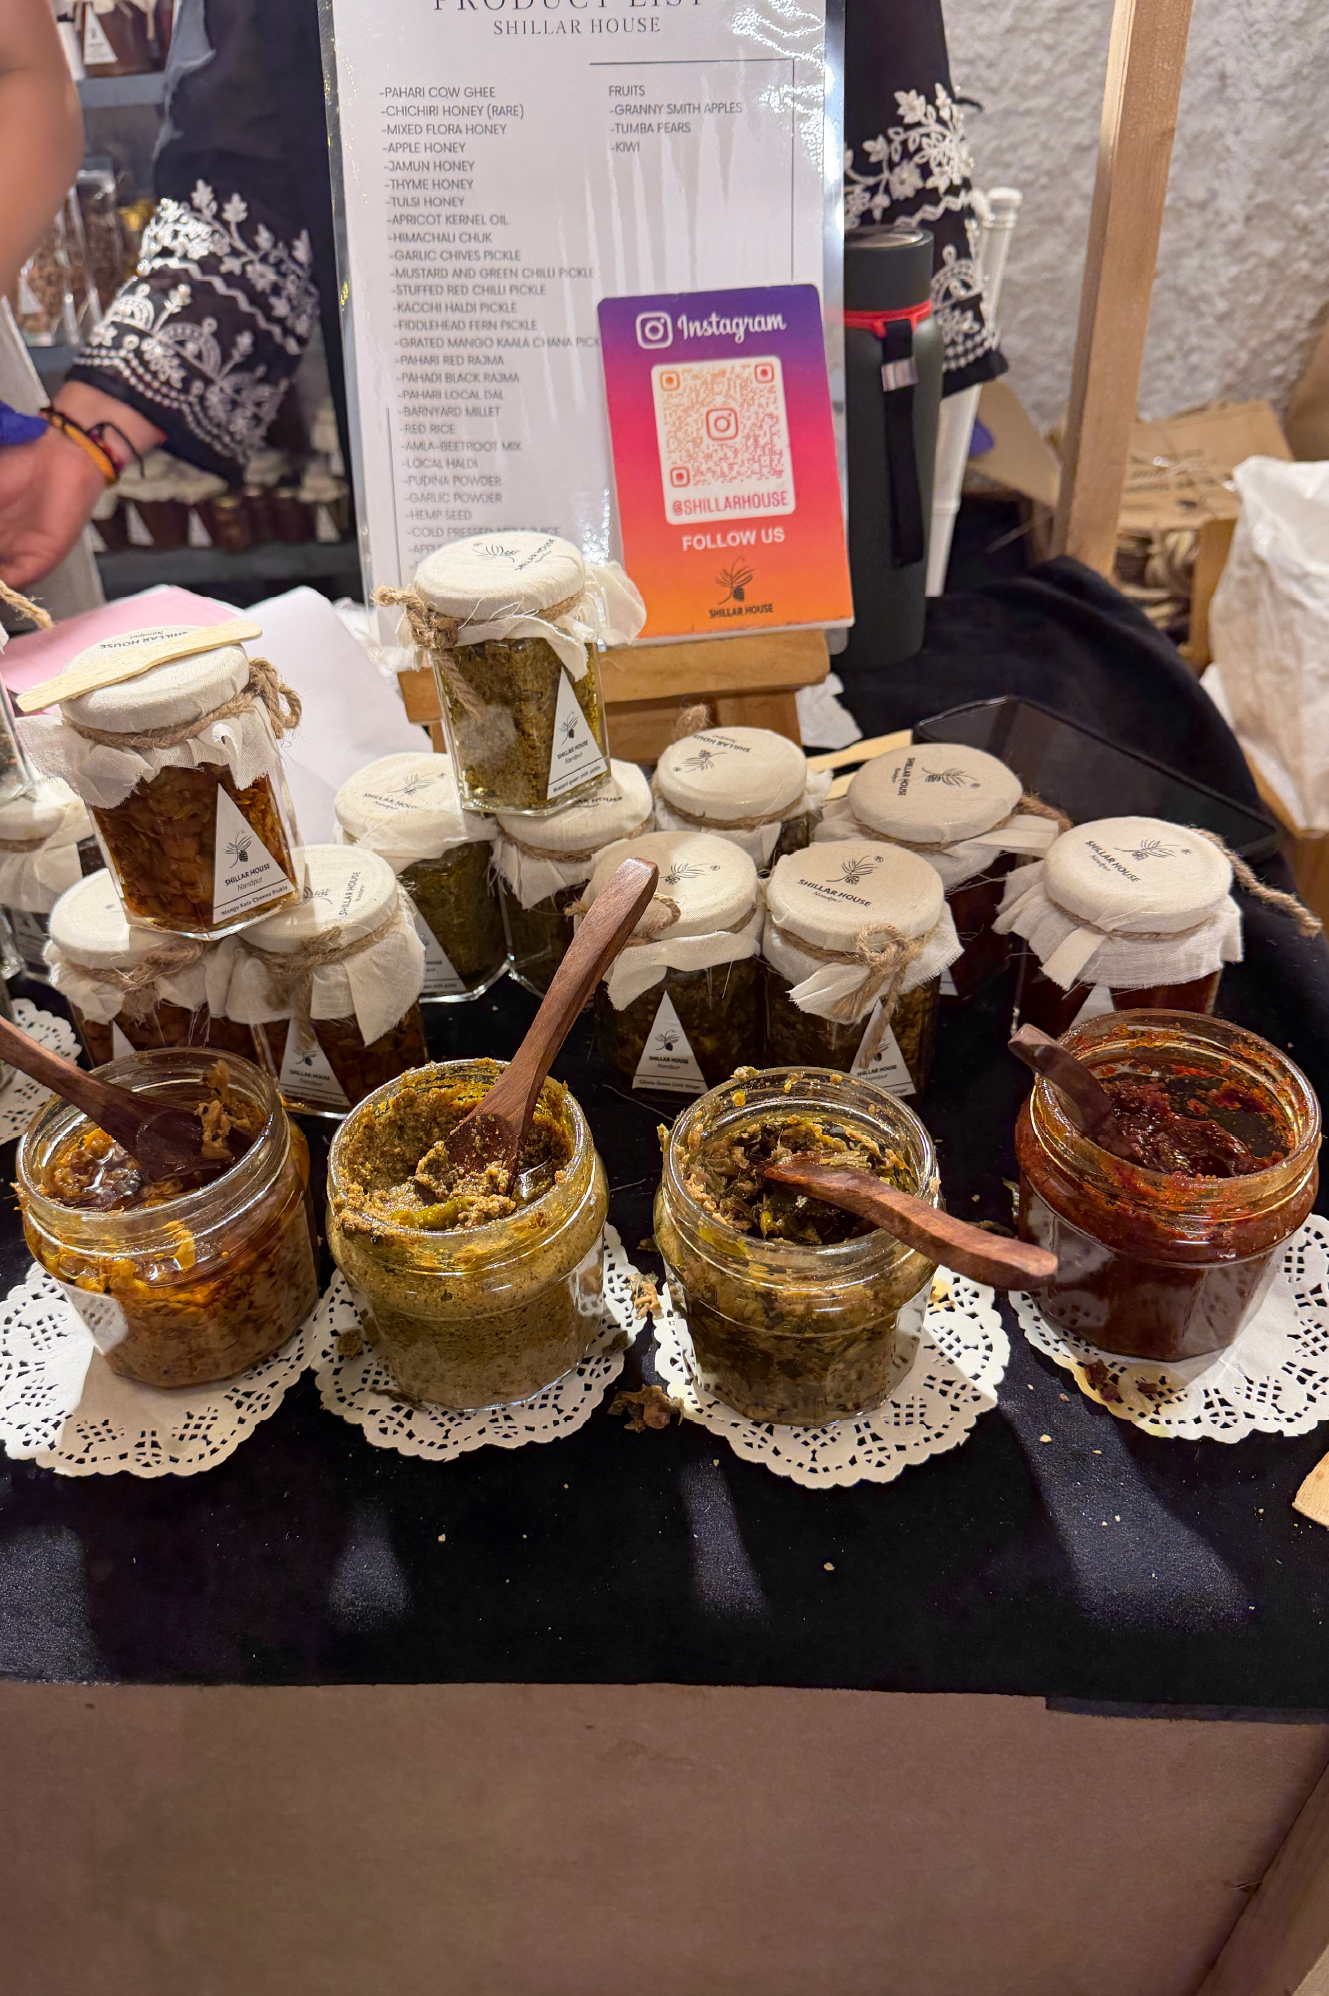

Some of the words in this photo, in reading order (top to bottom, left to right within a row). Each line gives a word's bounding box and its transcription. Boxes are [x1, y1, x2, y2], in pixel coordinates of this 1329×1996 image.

[493, 19, 582, 35] SHILLAR
[590, 17, 661, 33] HOUSE
[379, 87, 424, 98] -PAHARI
[429, 87, 460, 98] COW
[464, 87, 495, 98] GHEE
[608, 86, 645, 96] FRUITS
[381, 105, 438, 117] -CHICHIRI
[443, 105, 483, 117] HONEY
[487, 104, 524, 120] (RARE)
[610, 104, 664, 115] -GRANNY
[667, 104, 700, 114] SMITH
[704, 103, 742, 113] APPLES
[382, 124, 422, 135] -MIXED
[426, 124, 462, 135] FLORA
[466, 124, 507, 135] HONEY
[611, 124, 654, 134] -TUMBA
[383, 143, 420, 153] -APPLE
[424, 143, 466, 153] HONEY
[611, 142, 640, 152] -KIWI
[384, 161, 430, 171] -JAMUN
[434, 161, 474, 171] HONEY
[385, 179, 429, 190] -THYME
[432, 179, 474, 190] HONEY
[386, 197, 420, 207] -TULSI
[424, 197, 464, 207] HONEY
[387, 215, 441, 225] -APRICOT
[445, 215, 486, 225] KERNEL
[489, 215, 508, 225] OIL
[388, 233, 455, 243] -HIMACHALI
[459, 233, 492, 243] CHUK
[389, 250, 436, 261] -GARLIC
[440, 250, 480, 261] CHIVES
[484, 250, 521, 261] PICKLE
[390, 268, 448, 279] -MUSTARD
[452, 268, 476, 279] AND
[480, 268, 518, 279] GREEN
[522, 268, 555, 279] CHILLI
[559, 268, 595, 279] PICKLE
[391, 285, 443, 295] -STUFFED
[447, 285, 468, 295] RED
[472, 285, 505, 295] CHILLI
[510, 285, 546, 295] PICKLE
[393, 303, 441, 313] -KACCHI
[445, 303, 476, 313] HALDI
[480, 303, 516, 313] PICKLE
[393, 320, 466, 331] -FIDDLEHEAD
[469, 320, 497, 331] FERN
[501, 320, 537, 331] PICKLE
[677, 311, 786, 344] Instagram
[394, 338, 444, 349] -GRATED
[448, 338, 494, 349] MANGO
[576, 338, 600, 349] PICK
[395, 355, 439, 366] -PAHARI
[443, 355, 464, 366] RED
[468, 355, 504, 366] RAJMA
[445, 373, 482, 383] BLACK
[484, 373, 520, 383] RAJMA
[445, 390, 482, 400] LOCAL
[484, 390, 505, 400] DAL
[465, 407, 501, 417] MILLET
[430, 424, 455, 434] RICE
[502, 442, 522, 451] MIX
[446, 458, 478, 468] HALDI
[453, 476, 502, 486] POWDER
[454, 493, 502, 503] POWDER
[672, 490, 789, 516] @SHILLARHOUSE
[445, 510, 472, 520] SEED
[682, 530, 756, 552] FOLLOW
[761, 526, 785, 544] US
[709, 608, 742, 619] SHILLAR
[745, 604, 773, 614] HOUSE
[143, 632, 188, 642] HILLAR
[100, 640, 139, 649] HOUSE
[693, 735, 715, 744] HOUS
[557, 747, 574, 759] SHILLAR
[575, 740, 588, 750] HOUSE
[1085, 841, 1115, 863] SHILLAR
[1111, 862, 1140, 882] HOUSE
[225, 872, 249, 886] SHILLAR
[250, 863, 270, 876] HOUSE
[237, 877, 263, 891] Nandpur
[339, 891, 354, 915] SHILLAR
[347, 872, 361, 891] HOUSE
[798, 879, 837, 896] SHILLAR
[838, 892, 871, 907] HOUSE
[222, 906, 239, 915] Mango
[272, 885, 288, 895] Pickle
[857, 1068, 879, 1076] SHILLAR
